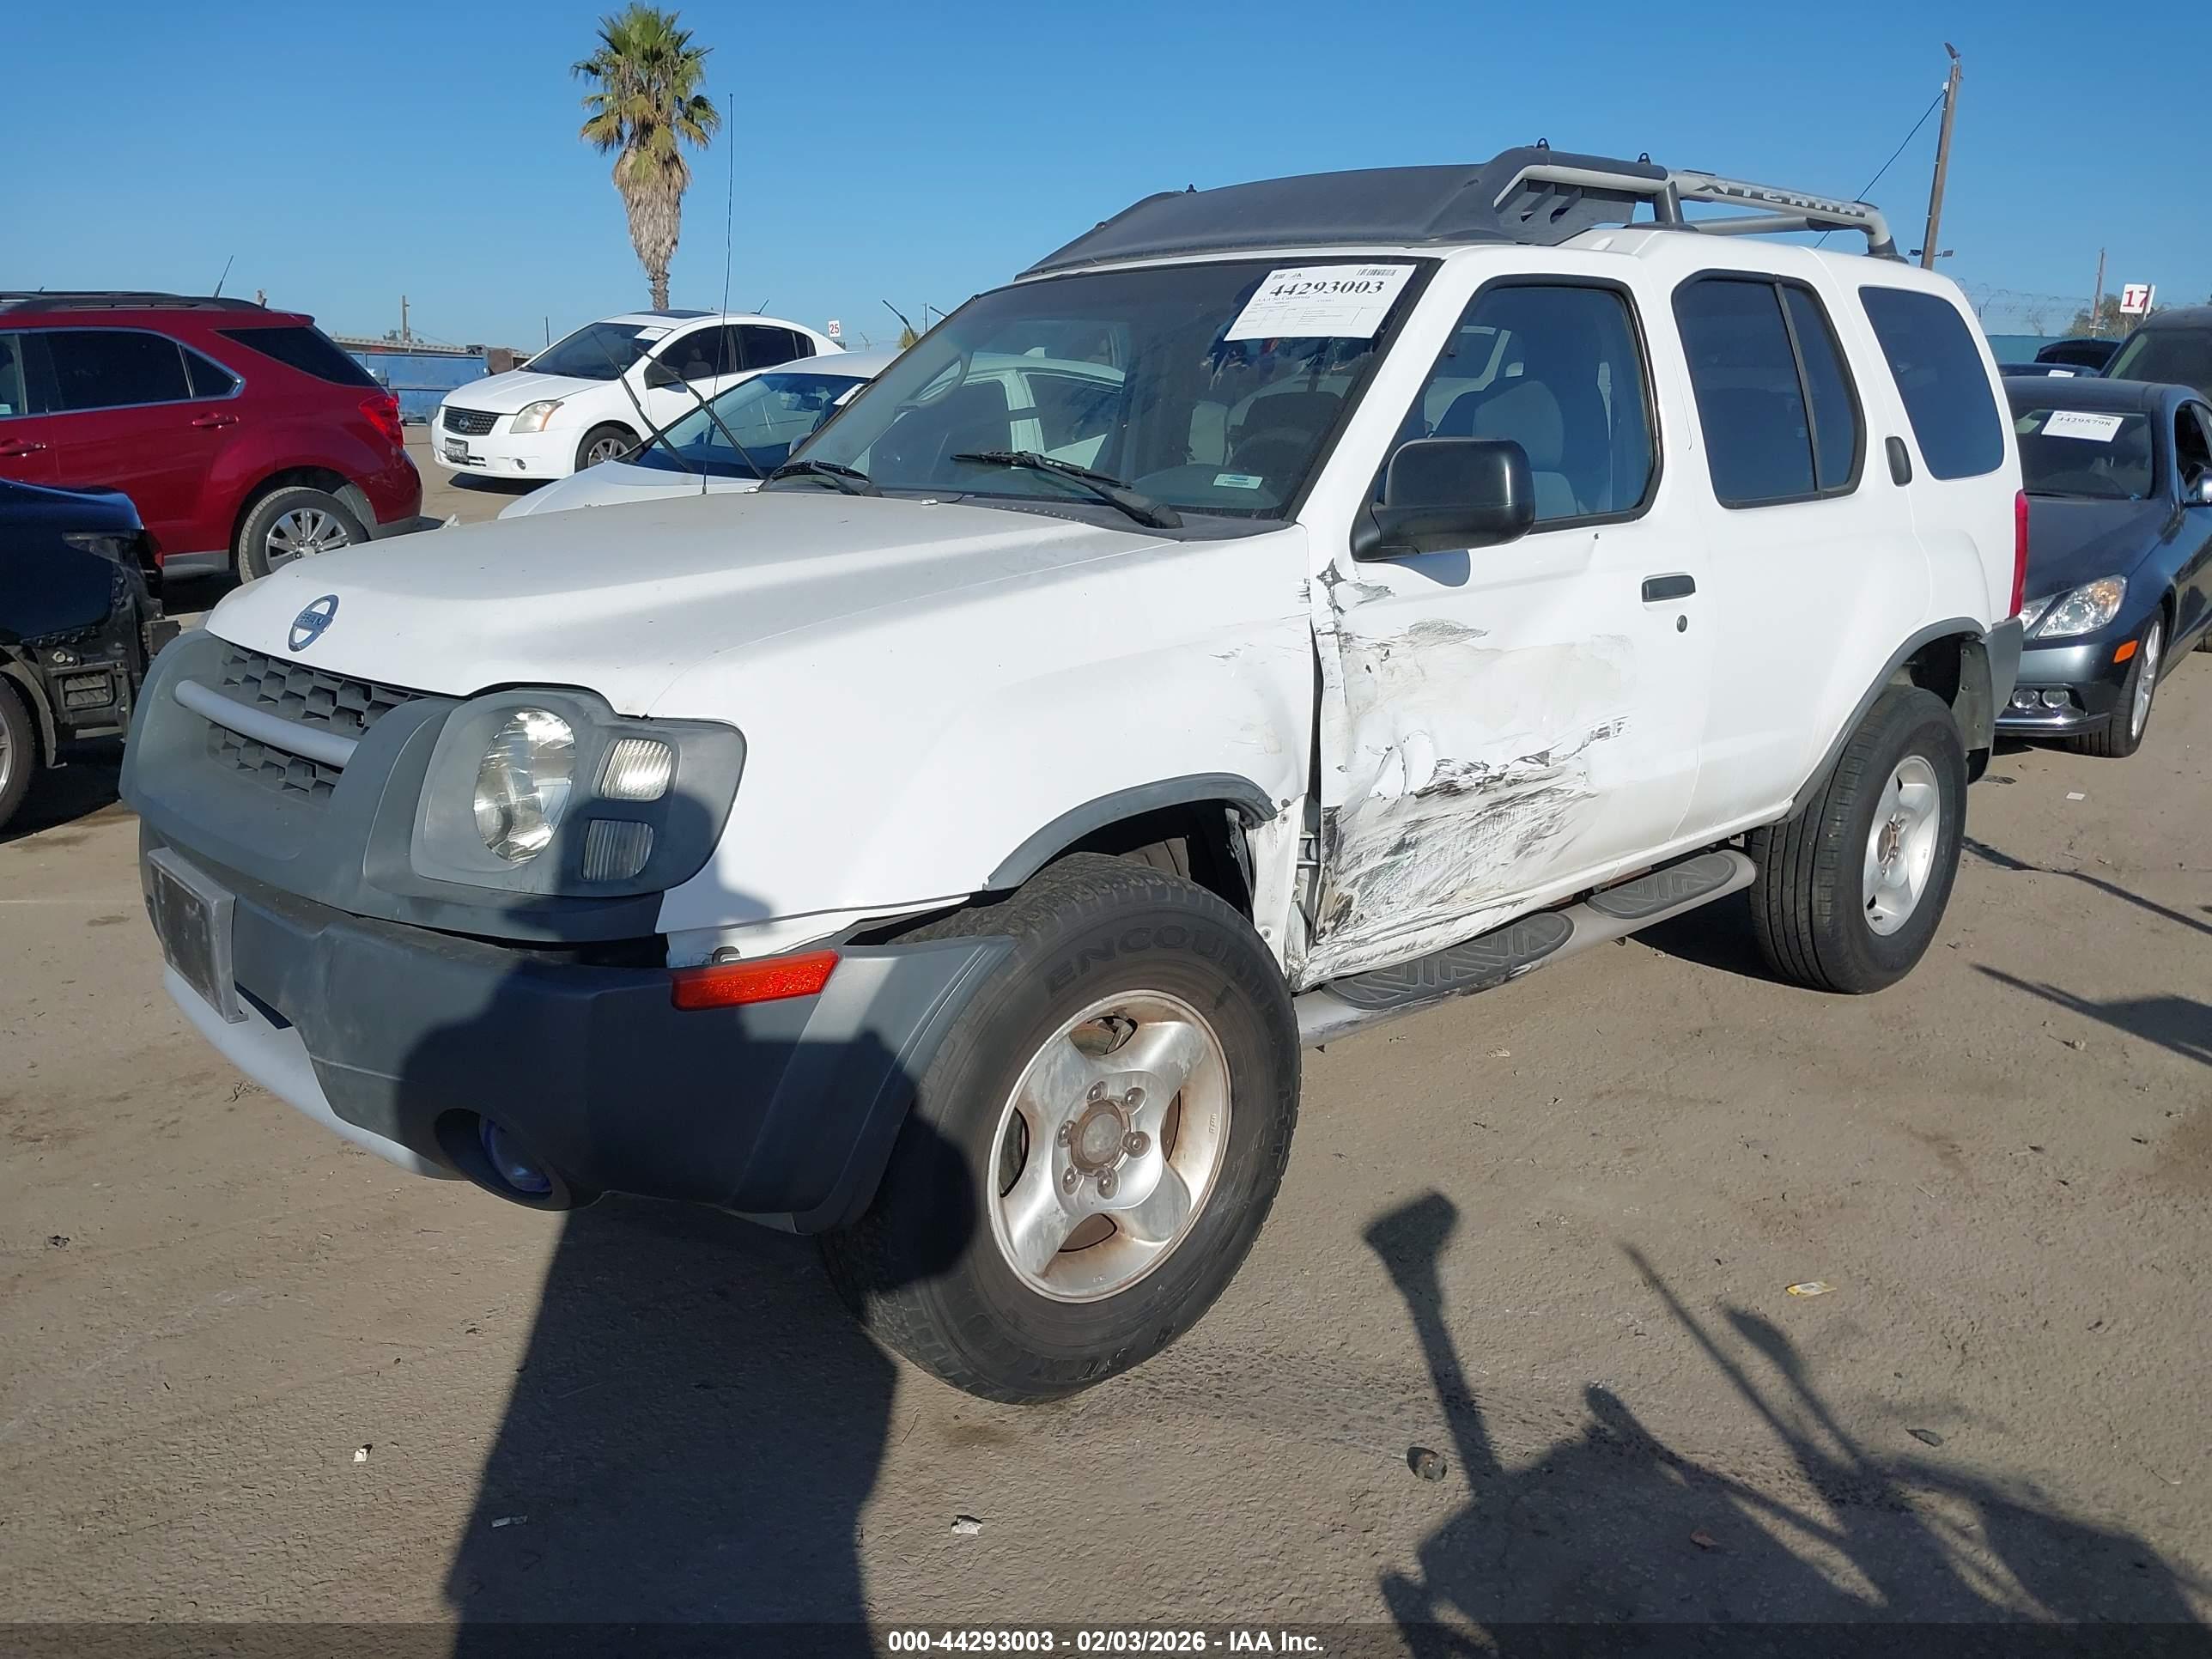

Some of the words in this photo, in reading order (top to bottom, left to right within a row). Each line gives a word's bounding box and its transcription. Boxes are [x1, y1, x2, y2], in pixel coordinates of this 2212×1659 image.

[1270, 281, 1385, 297] 44293003
[2123, 290, 2148, 307] 17
[830, 323, 840, 334] 25
